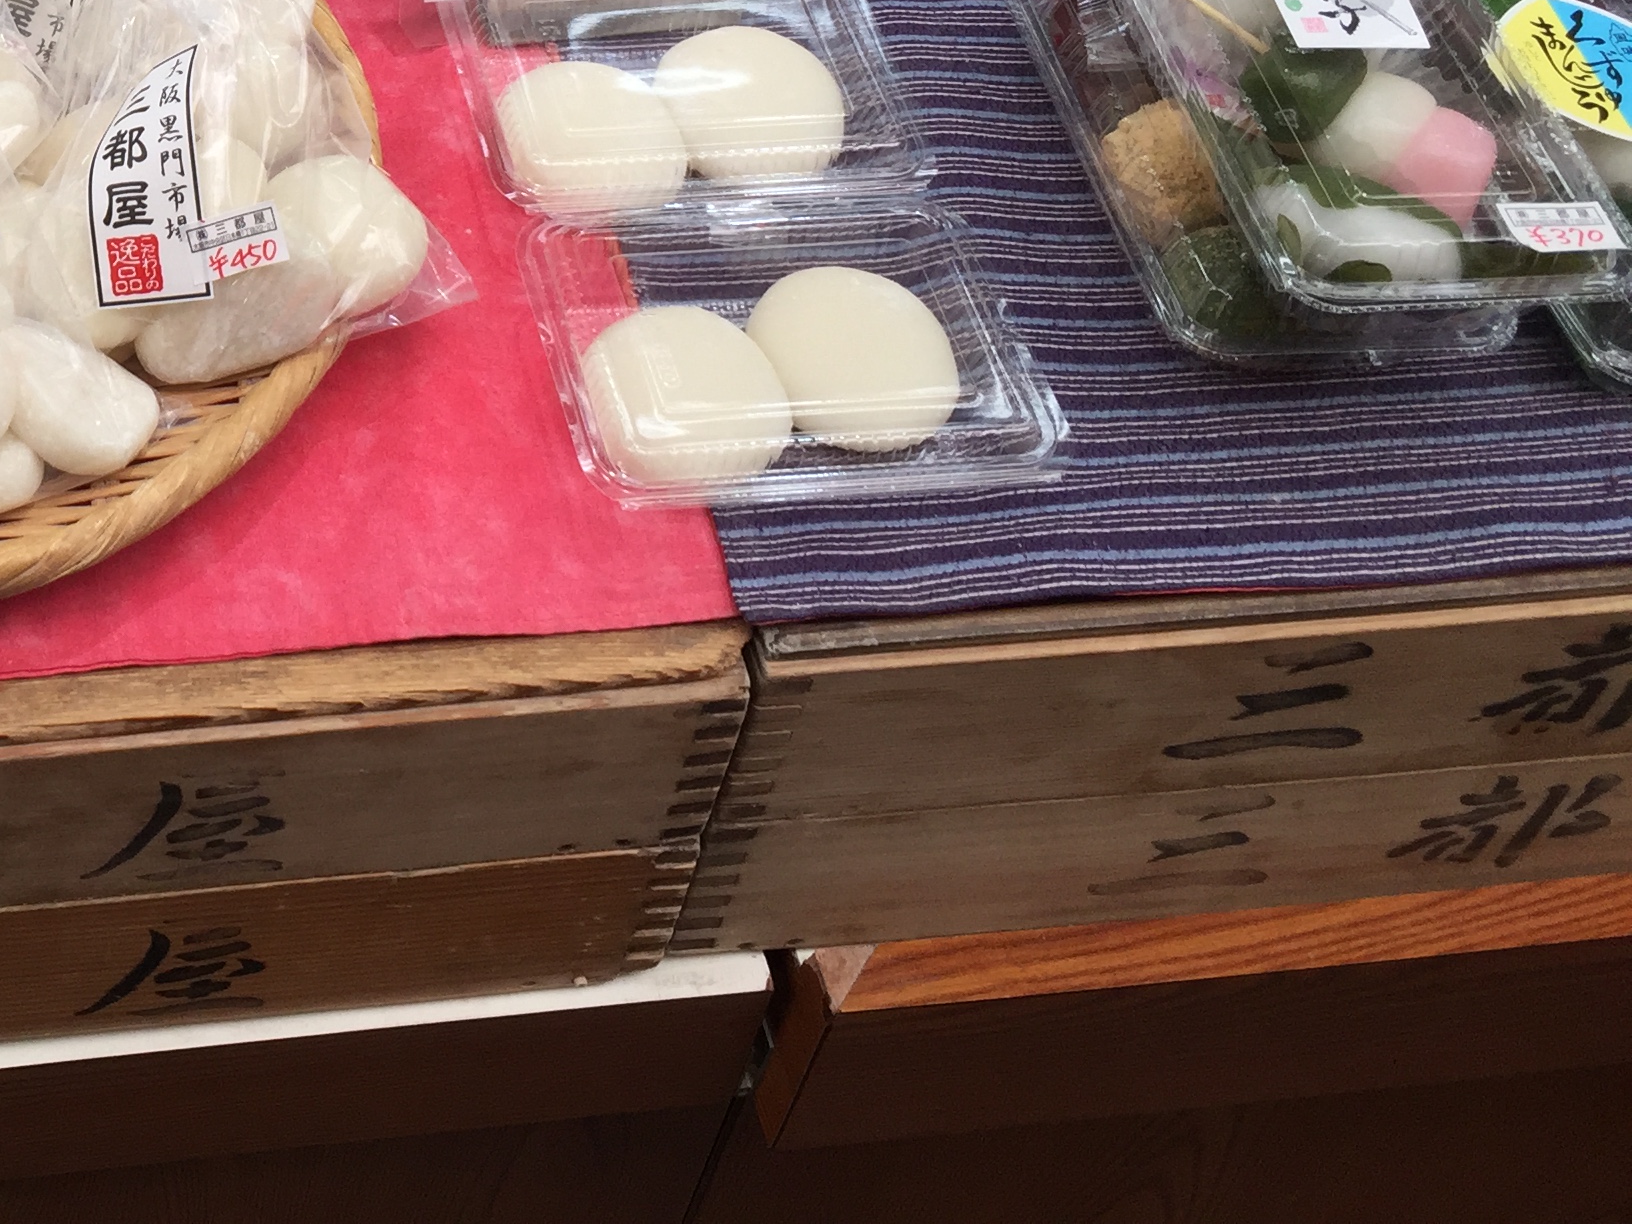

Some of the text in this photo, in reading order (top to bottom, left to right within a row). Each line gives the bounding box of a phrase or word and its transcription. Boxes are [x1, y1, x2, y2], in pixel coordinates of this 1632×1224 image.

[102, 84, 155, 229] 三都屋
[158, 58, 188, 242] 大阪黒門市場
[139, 236, 161, 291] こだわりの
[209, 239, 277, 278] ¥450
[1526, 225, 1604, 247] ¥370
[109, 238, 144, 293] 逸品
